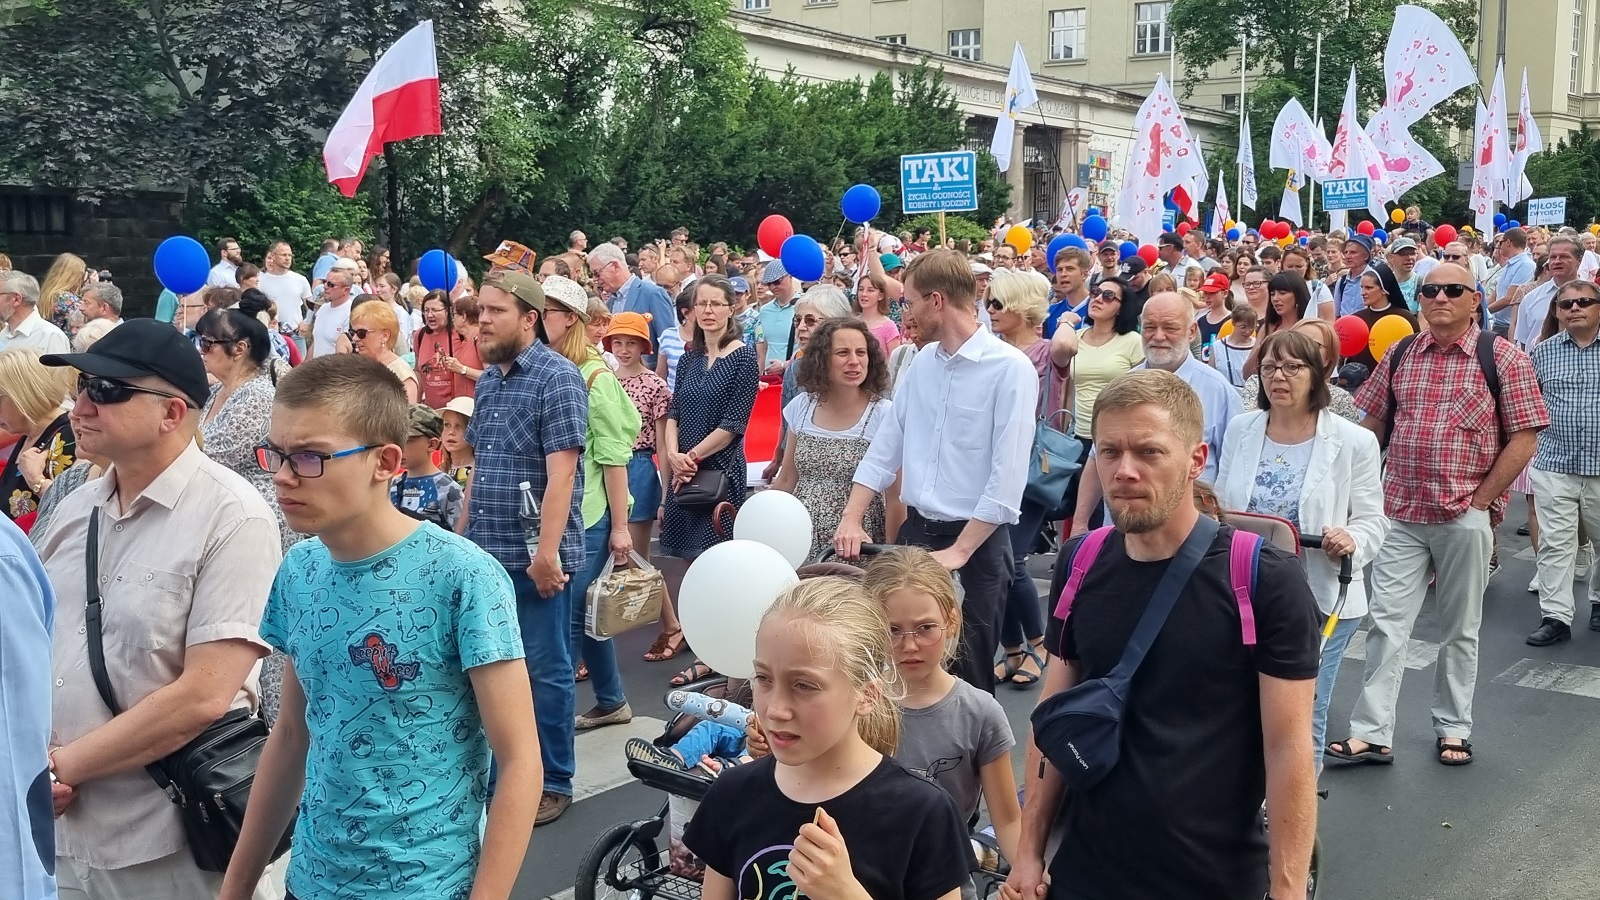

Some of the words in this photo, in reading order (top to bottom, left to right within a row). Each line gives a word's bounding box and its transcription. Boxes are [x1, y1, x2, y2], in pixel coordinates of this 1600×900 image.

[904, 156, 969, 184] TAK!
[908, 192, 927, 200] ŻYCIA
[932, 190, 970, 200] GODNOŚCI
[1324, 180, 1365, 196] TAK!
[908, 200, 936, 208] KOBIETY
[941, 200, 971, 208] RODZINY
[350, 647, 380, 662] keep
